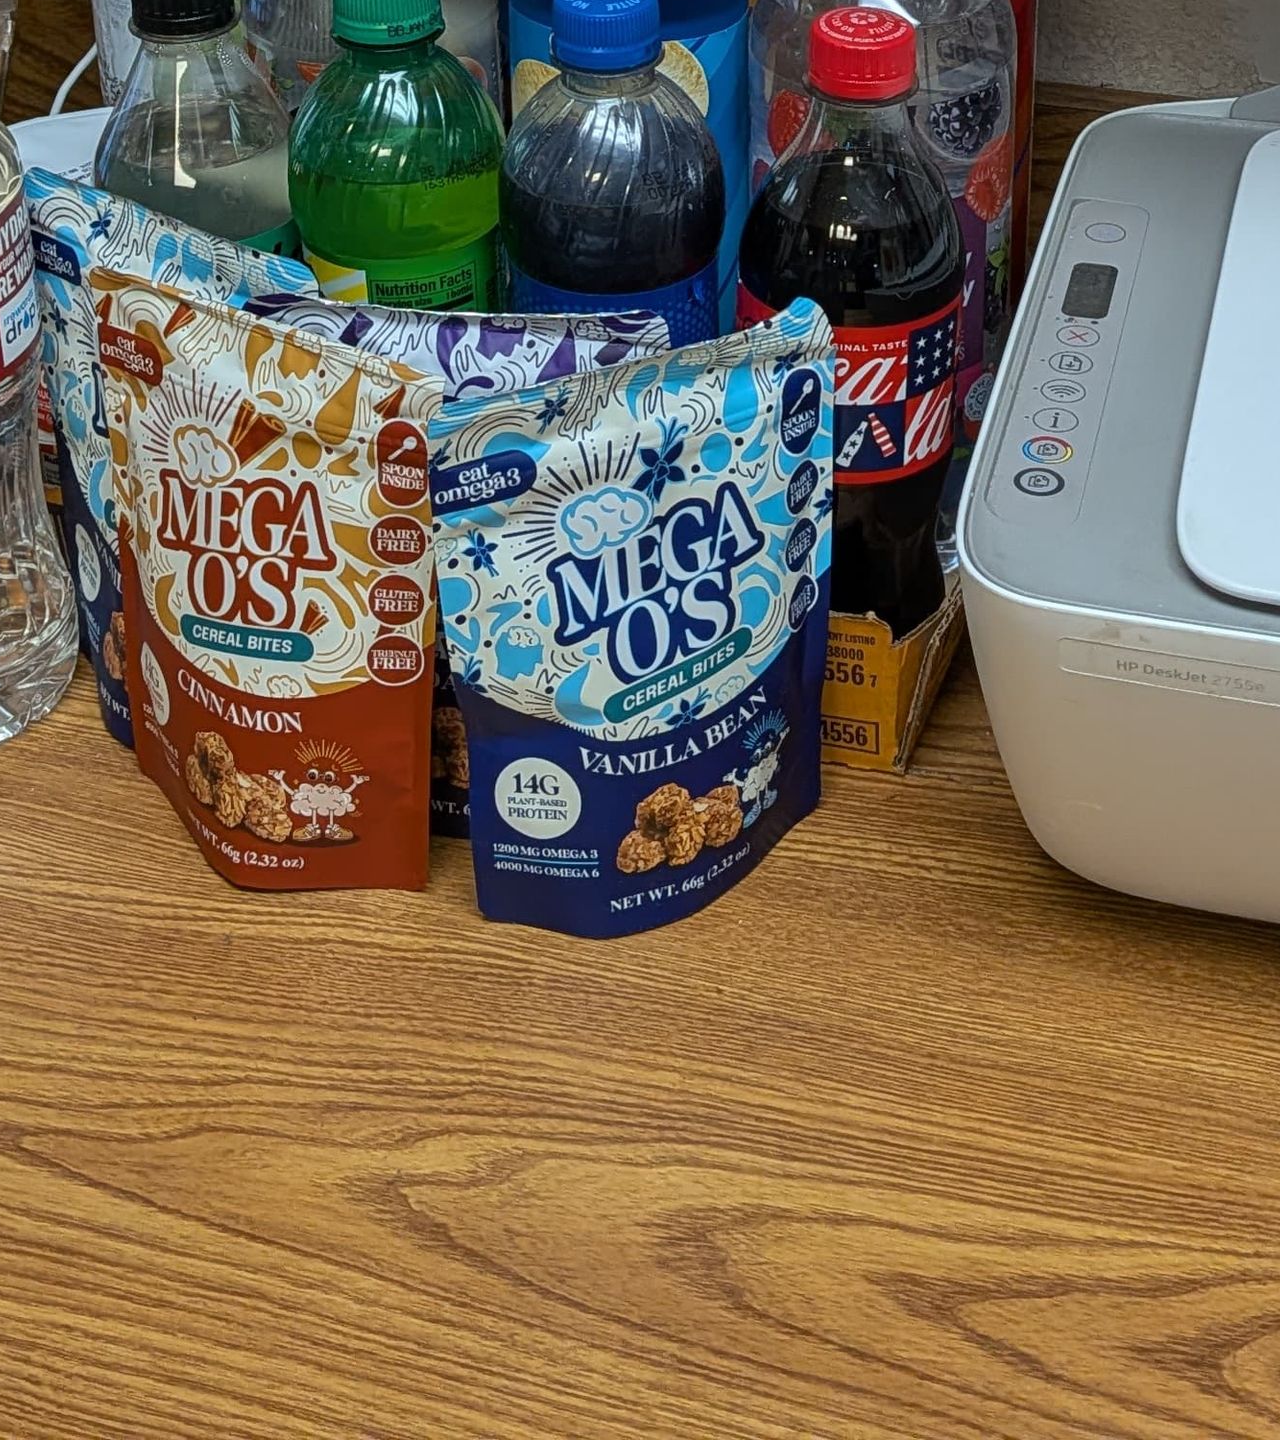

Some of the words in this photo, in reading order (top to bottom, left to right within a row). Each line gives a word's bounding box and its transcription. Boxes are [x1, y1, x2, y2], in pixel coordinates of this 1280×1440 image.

[375, 280, 437, 297] Nutrition
[439, 268, 472, 289] Facts
[100, 342, 154, 376] omega3
[116, 336, 138, 354] eat
[380, 461, 425, 480] SPOON
[380, 474, 425, 491] INSIDE
[458, 461, 492, 484] eat
[434, 467, 522, 506] omega3
[162, 475, 329, 560] MEGA
[376, 526, 421, 540] DAIRY
[376, 538, 421, 554] FREE
[556, 488, 760, 632] MEGA
[193, 553, 295, 628] O'S
[192, 625, 244, 648] CEREAL
[247, 634, 294, 655] BITES
[616, 576, 733, 677] O'S
[622, 670, 690, 712] CEREAL
[691, 641, 736, 685] BITES
[1116, 659, 1139, 674] HP
[1143, 662, 1208, 685] DeskJet
[177, 668, 303, 734] CINNAMON
[579, 729, 702, 777] VANILLA
[704, 686, 768, 749] BEAN
[512, 773, 560, 796] 14G
[507, 806, 568, 822] PROTEIN
